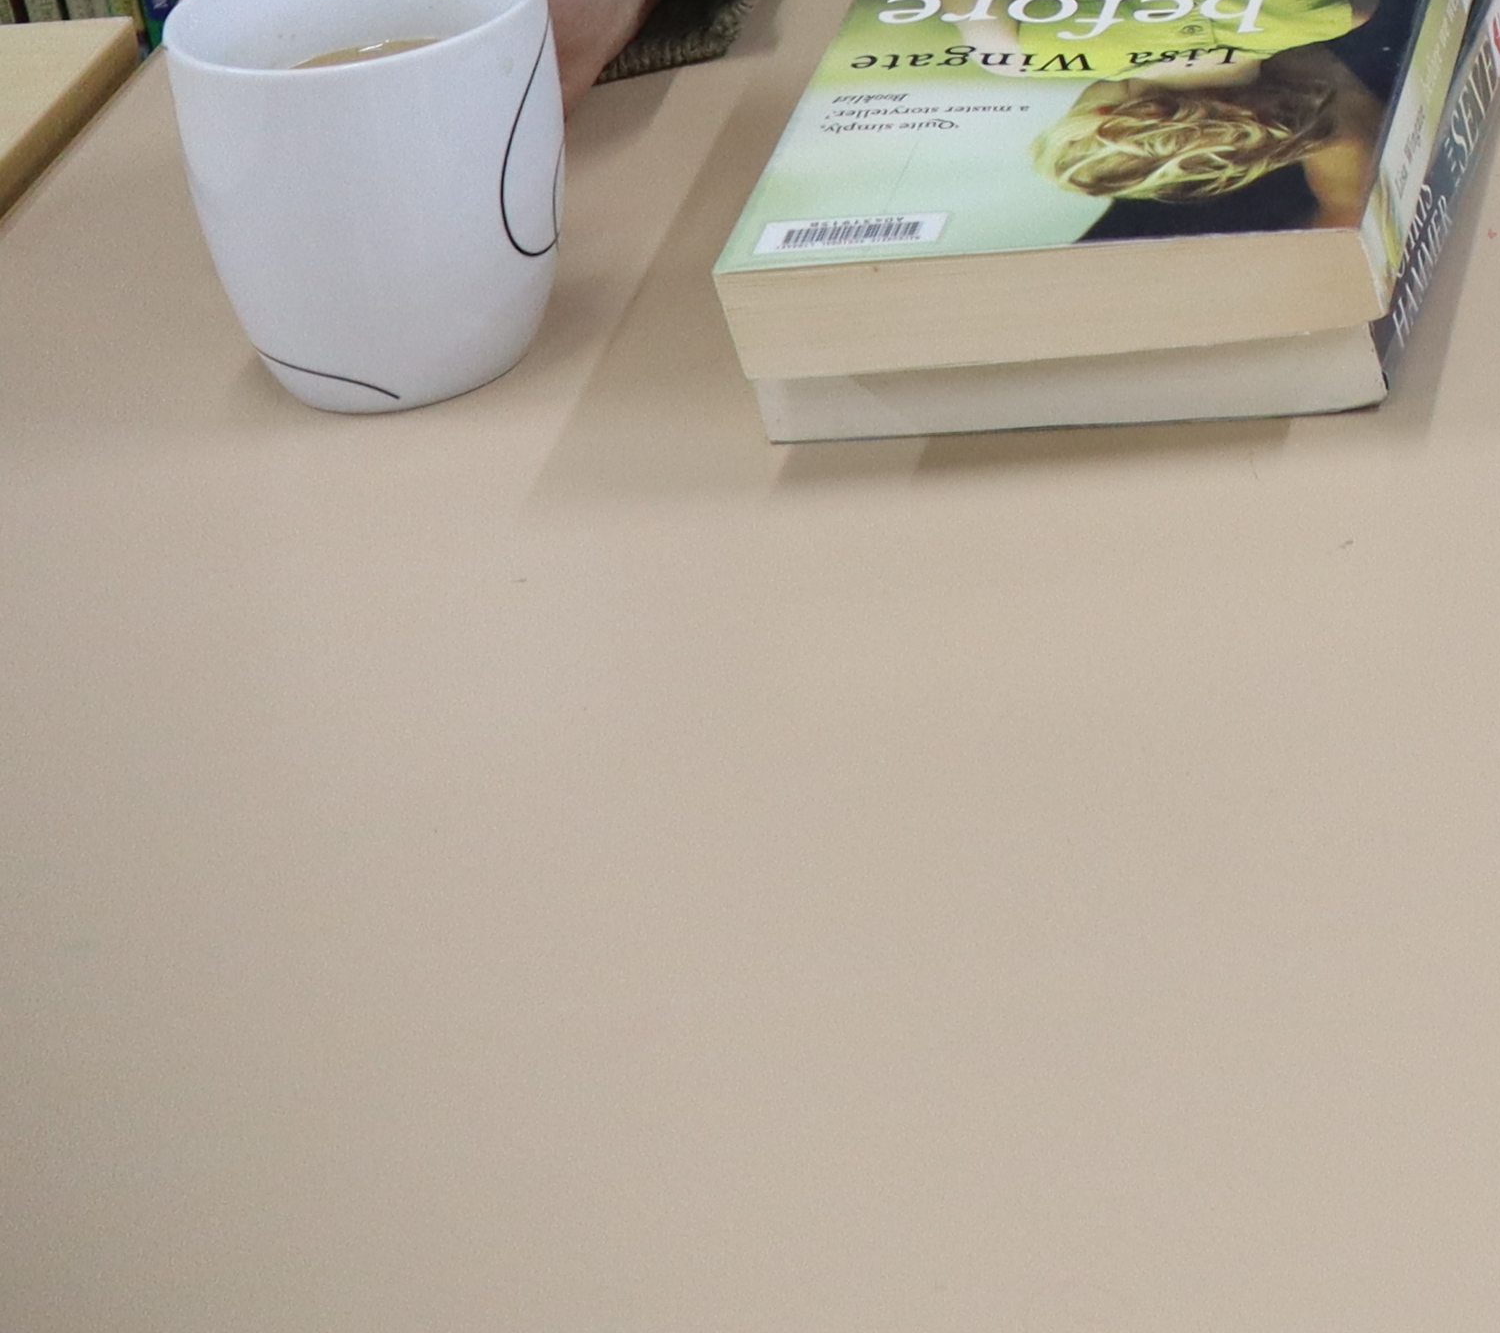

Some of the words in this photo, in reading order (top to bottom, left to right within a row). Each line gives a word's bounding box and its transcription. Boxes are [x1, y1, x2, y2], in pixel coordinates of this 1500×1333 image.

[851, 45, 1094, 74] Wingate
[1128, 46, 1234, 65] Lisa
[832, 92, 909, 104] Booklist
[945, 104, 1012, 114] master
[1019, 105, 1030, 113] a
